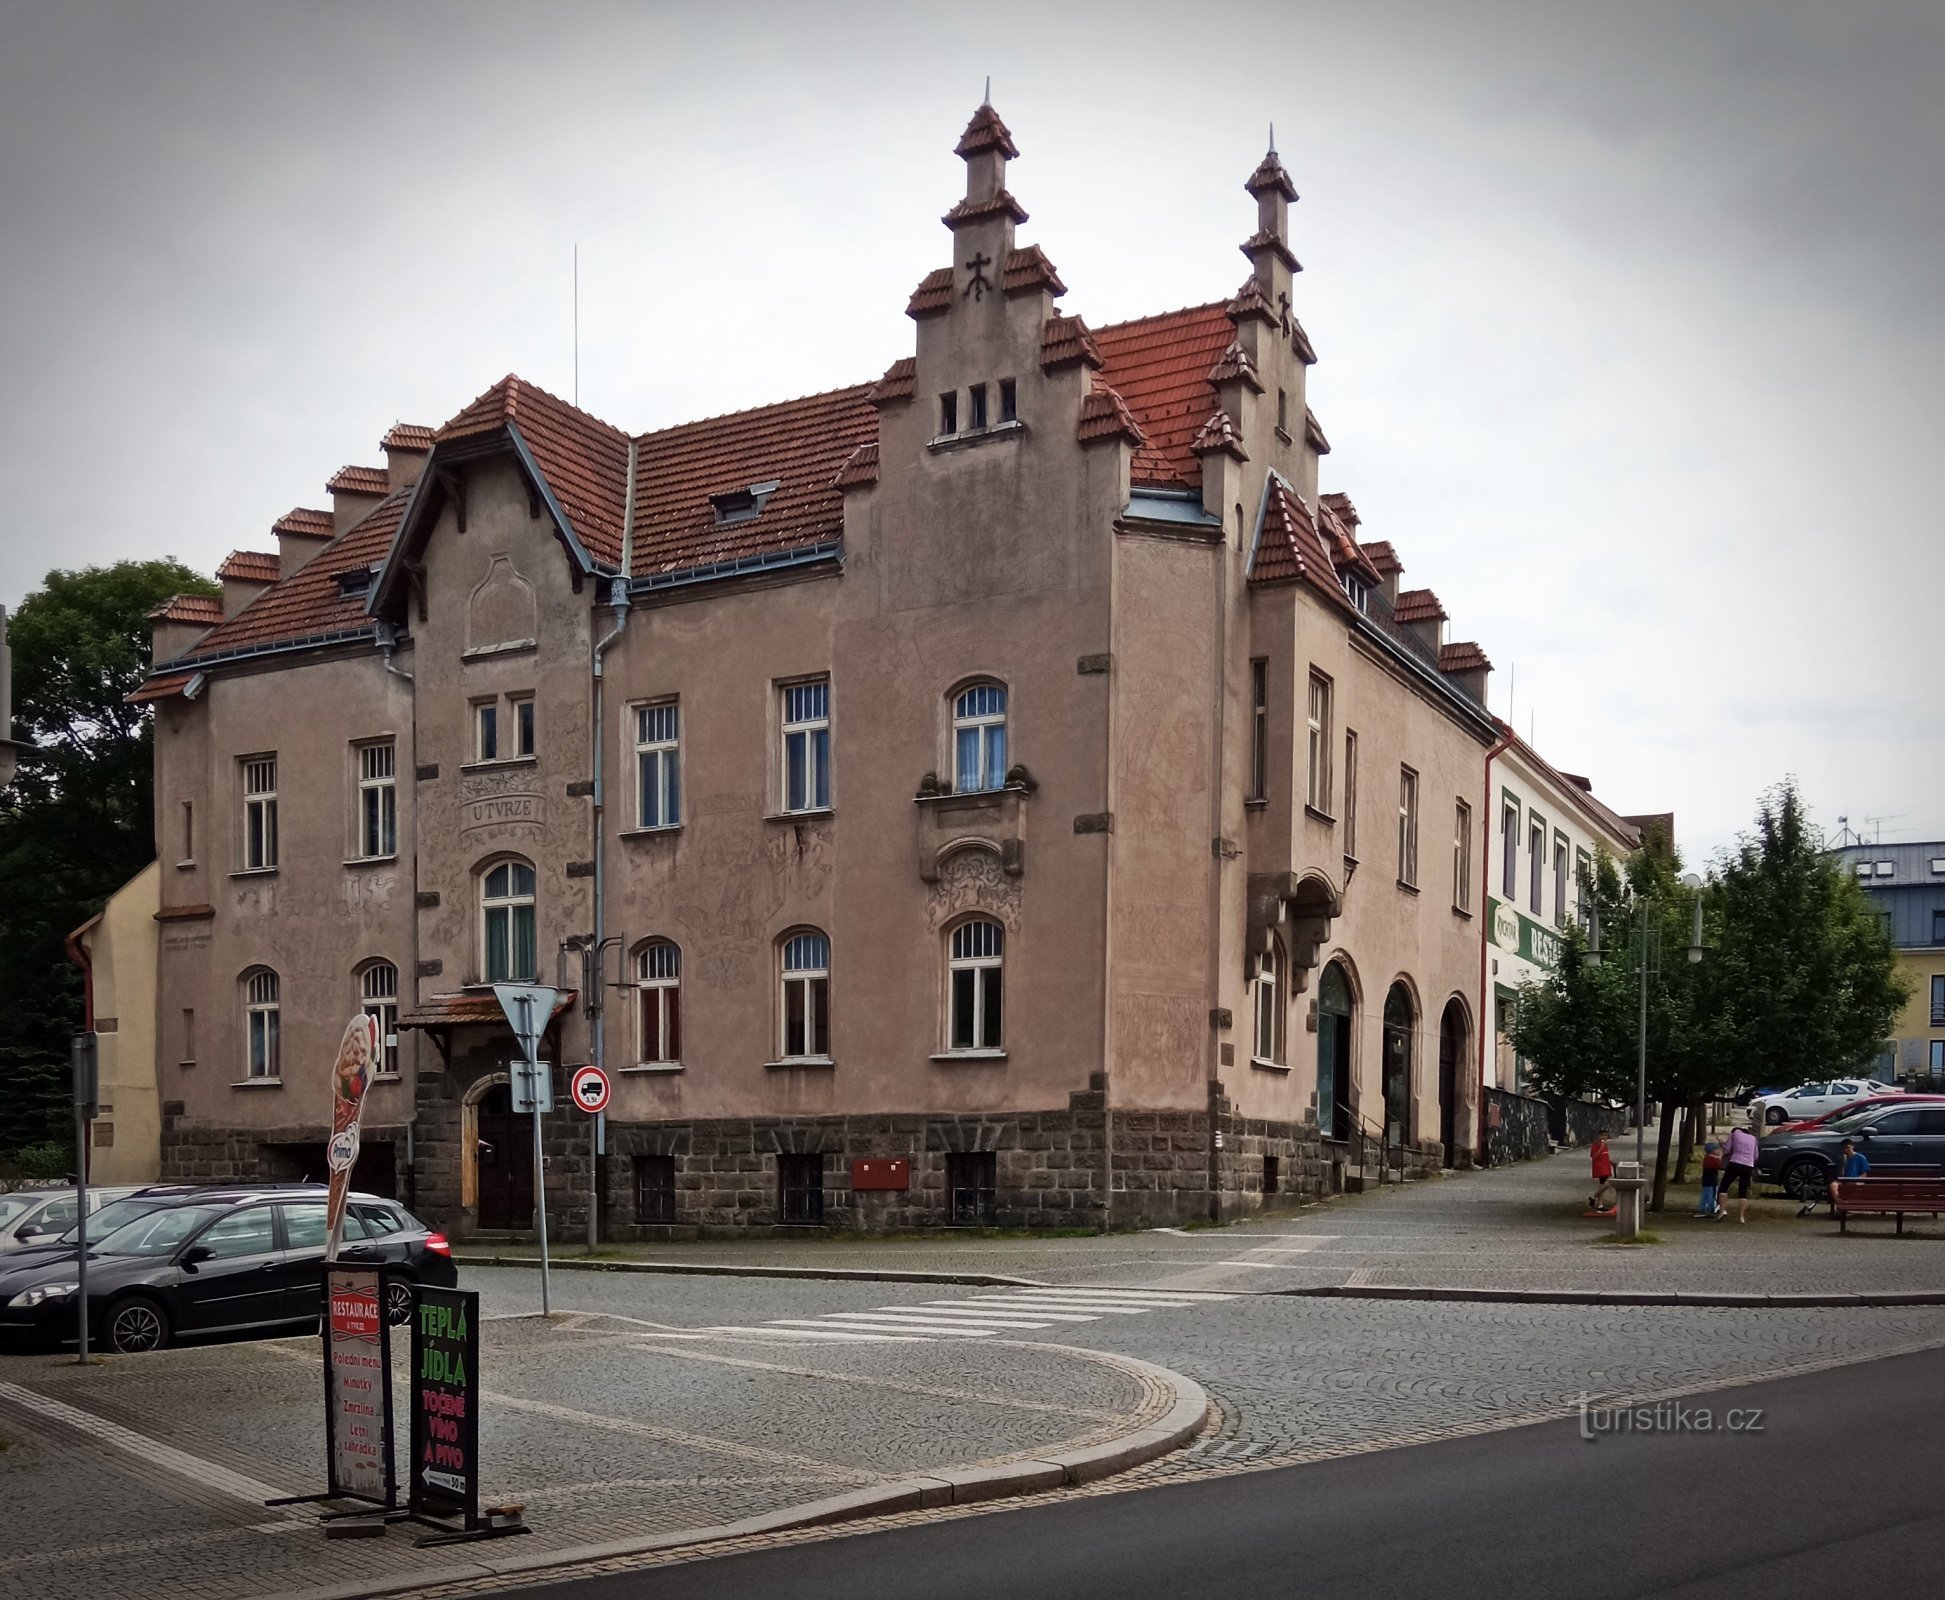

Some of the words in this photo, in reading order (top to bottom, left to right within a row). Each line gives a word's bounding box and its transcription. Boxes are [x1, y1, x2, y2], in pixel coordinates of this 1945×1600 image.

[474, 806, 483, 820] U
[485, 800, 531, 819] TVRZE
[332, 1301, 378, 1319] RESTAURACE
[419, 1299, 467, 1342] TEPLÁ
[361, 1356, 381, 1369] menu
[421, 1340, 467, 1387] JÍDLA
[343, 1376, 373, 1392] Minutky
[343, 1400, 375, 1417] Zmrzlina
[422, 1387, 465, 1418] TOČENÉ
[428, 1413, 458, 1442] VÍNO
[423, 1440, 434, 1463] A
[435, 1443, 464, 1470] PIVO
[451, 1476, 459, 1490] 50
